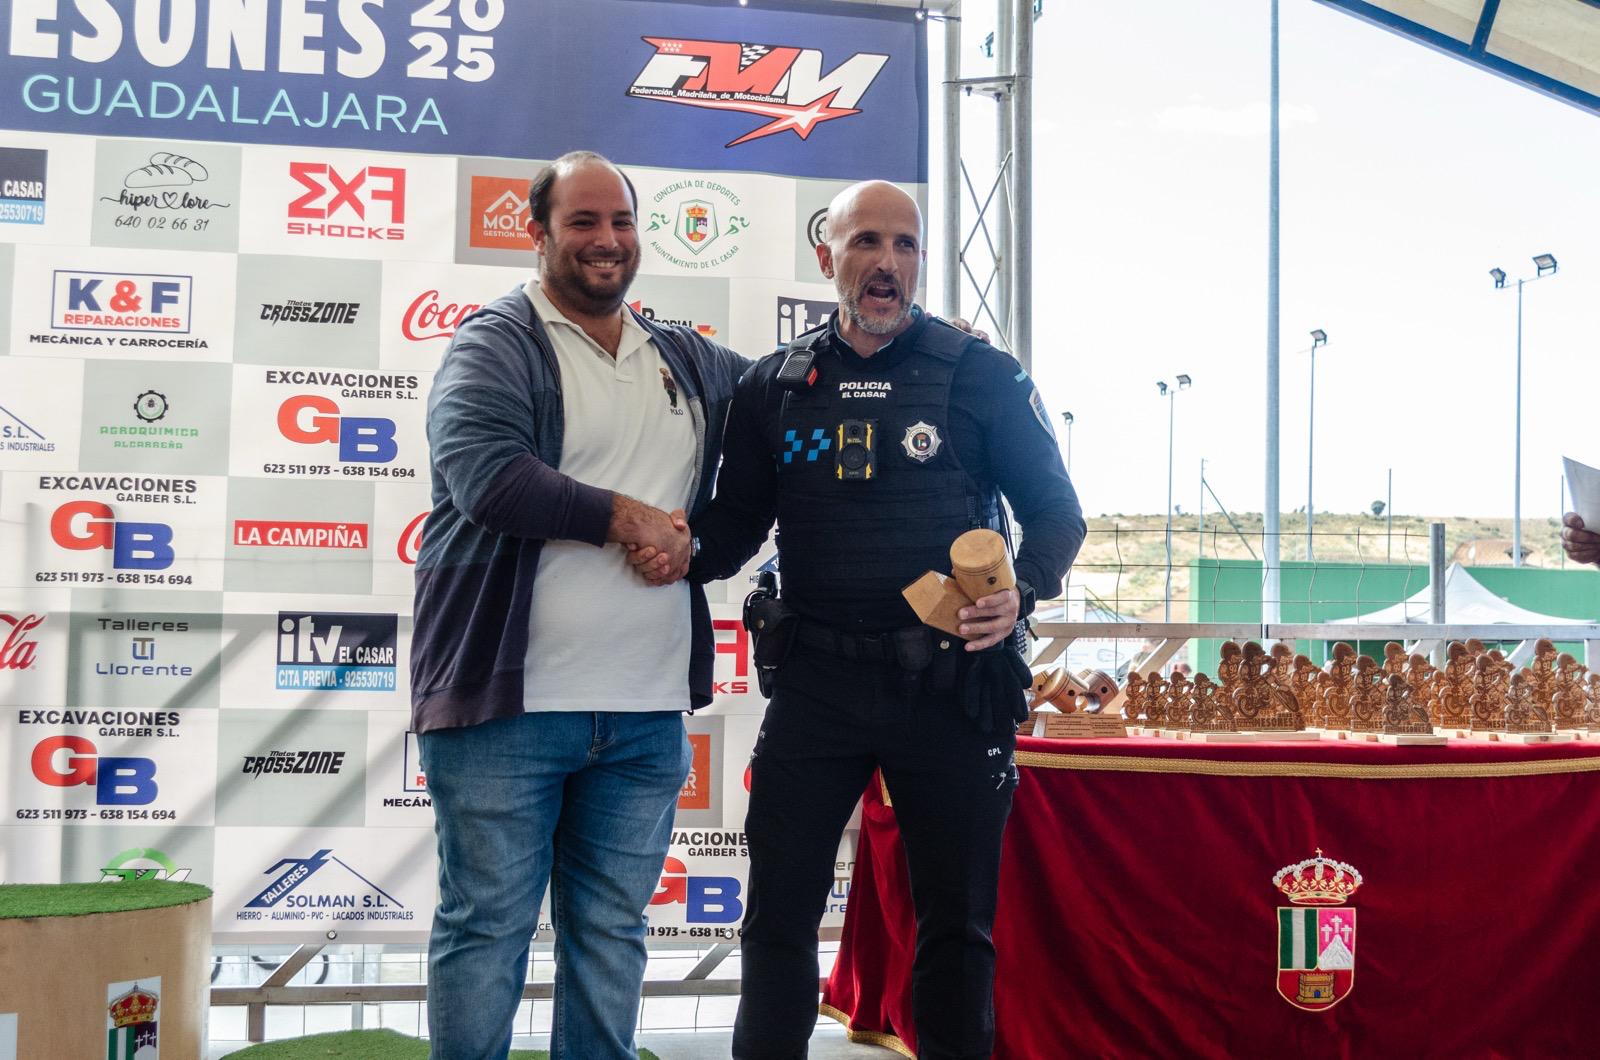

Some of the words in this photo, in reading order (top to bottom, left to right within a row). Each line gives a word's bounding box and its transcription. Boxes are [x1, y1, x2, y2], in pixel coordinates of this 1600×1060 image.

[407, 32, 495, 82] 25
[22, 74, 448, 135] GUADALAJARA
[4, 180, 43, 198] CASAR
[653, 180, 693, 203] CONCEJALÍA
[695, 180, 704, 188] DE
[706, 181, 741, 206] DEPORTES
[119, 189, 157, 211] hiper
[181, 192, 210, 209] lore
[115, 215, 141, 228] 640
[147, 216, 166, 229] 02
[171, 218, 188, 231] 66
[193, 219, 210, 231] 31
[287, 222, 405, 240] SHOCKS
[650, 241, 698, 269] AYUNTAMIENTO
[700, 261, 710, 269] DE
[711, 258, 719, 267] EL
[720, 245, 739, 263] CASAR
[68, 278, 103, 312] K
[109, 280, 142, 313] &
[151, 281, 180, 313] F
[64, 314, 181, 328] REPARACIONES
[29, 333, 103, 346] MECÁNICA
[107, 338, 116, 346] Y
[119, 337, 208, 349] CARROCERÍA
[266, 370, 418, 389] EXCAVACIONES
[839, 381, 892, 391] POLICIA
[341, 389, 392, 399] GARBER
[396, 391, 418, 400] S.L.
[841, 391, 852, 399] EL
[853, 391, 886, 399] CASAR
[3, 426, 29, 439] S.L.
[277, 394, 398, 463] GB
[7, 442, 55, 452] INDUSTRIALES
[263, 464, 285, 474] 623
[289, 464, 306, 474] 511
[309, 465, 331, 475] 973
[342, 466, 365, 476] 638
[369, 467, 389, 477] 154
[392, 468, 415, 478] 694
[39, 476, 197, 493] EXCAVACIONES
[116, 493, 169, 503] GARBER
[174, 495, 196, 504] S.L.
[50, 500, 175, 570] GB
[238, 527, 262, 545] LA
[267, 525, 363, 547] CAMPIÑA
[35, 572, 57, 582] 623
[60, 572, 78, 582] 511
[82, 572, 104, 583] 973
[116, 573, 140, 584] 638
[144, 574, 164, 584] 154
[168, 575, 192, 585] 694
[98, 618, 189, 632] Talleres
[280, 616, 343, 663] itv
[339, 646, 353, 663] EL
[356, 647, 394, 664] CASAR
[96, 663, 192, 676] Llorente
[278, 670, 300, 686] CITA
[302, 670, 337, 687] PREVIA
[345, 670, 394, 688] 925530719
[19, 710, 180, 726] EXCAVACIONES
[1254, 718, 1293, 728] MESONES
[99, 727, 152, 737] GARBER
[156, 728, 180, 737] S.L.
[987, 747, 1002, 757] CPL
[31, 735, 158, 805] GB
[383, 797, 432, 807] MECÁN
[16, 809, 40, 820] 623
[43, 809, 61, 820] 511
[64, 809, 87, 820] 973
[100, 809, 124, 820] 638
[127, 809, 148, 820] 154
[151, 810, 176, 820] 694
[688, 848, 737, 857] GARBER
[261, 864, 309, 904] TALLERES
[286, 895, 355, 908] SOLMAN
[362, 895, 388, 908] S.L.
[236, 911, 262, 920] HIERRO
[271, 911, 305, 920] ALUMINIO
[311, 911, 324, 920] PVC
[332, 911, 365, 921] LACADOS
[367, 911, 414, 920] INDUSTRIALES
[658, 927, 678, 936] 973
[690, 927, 711, 937] 638
